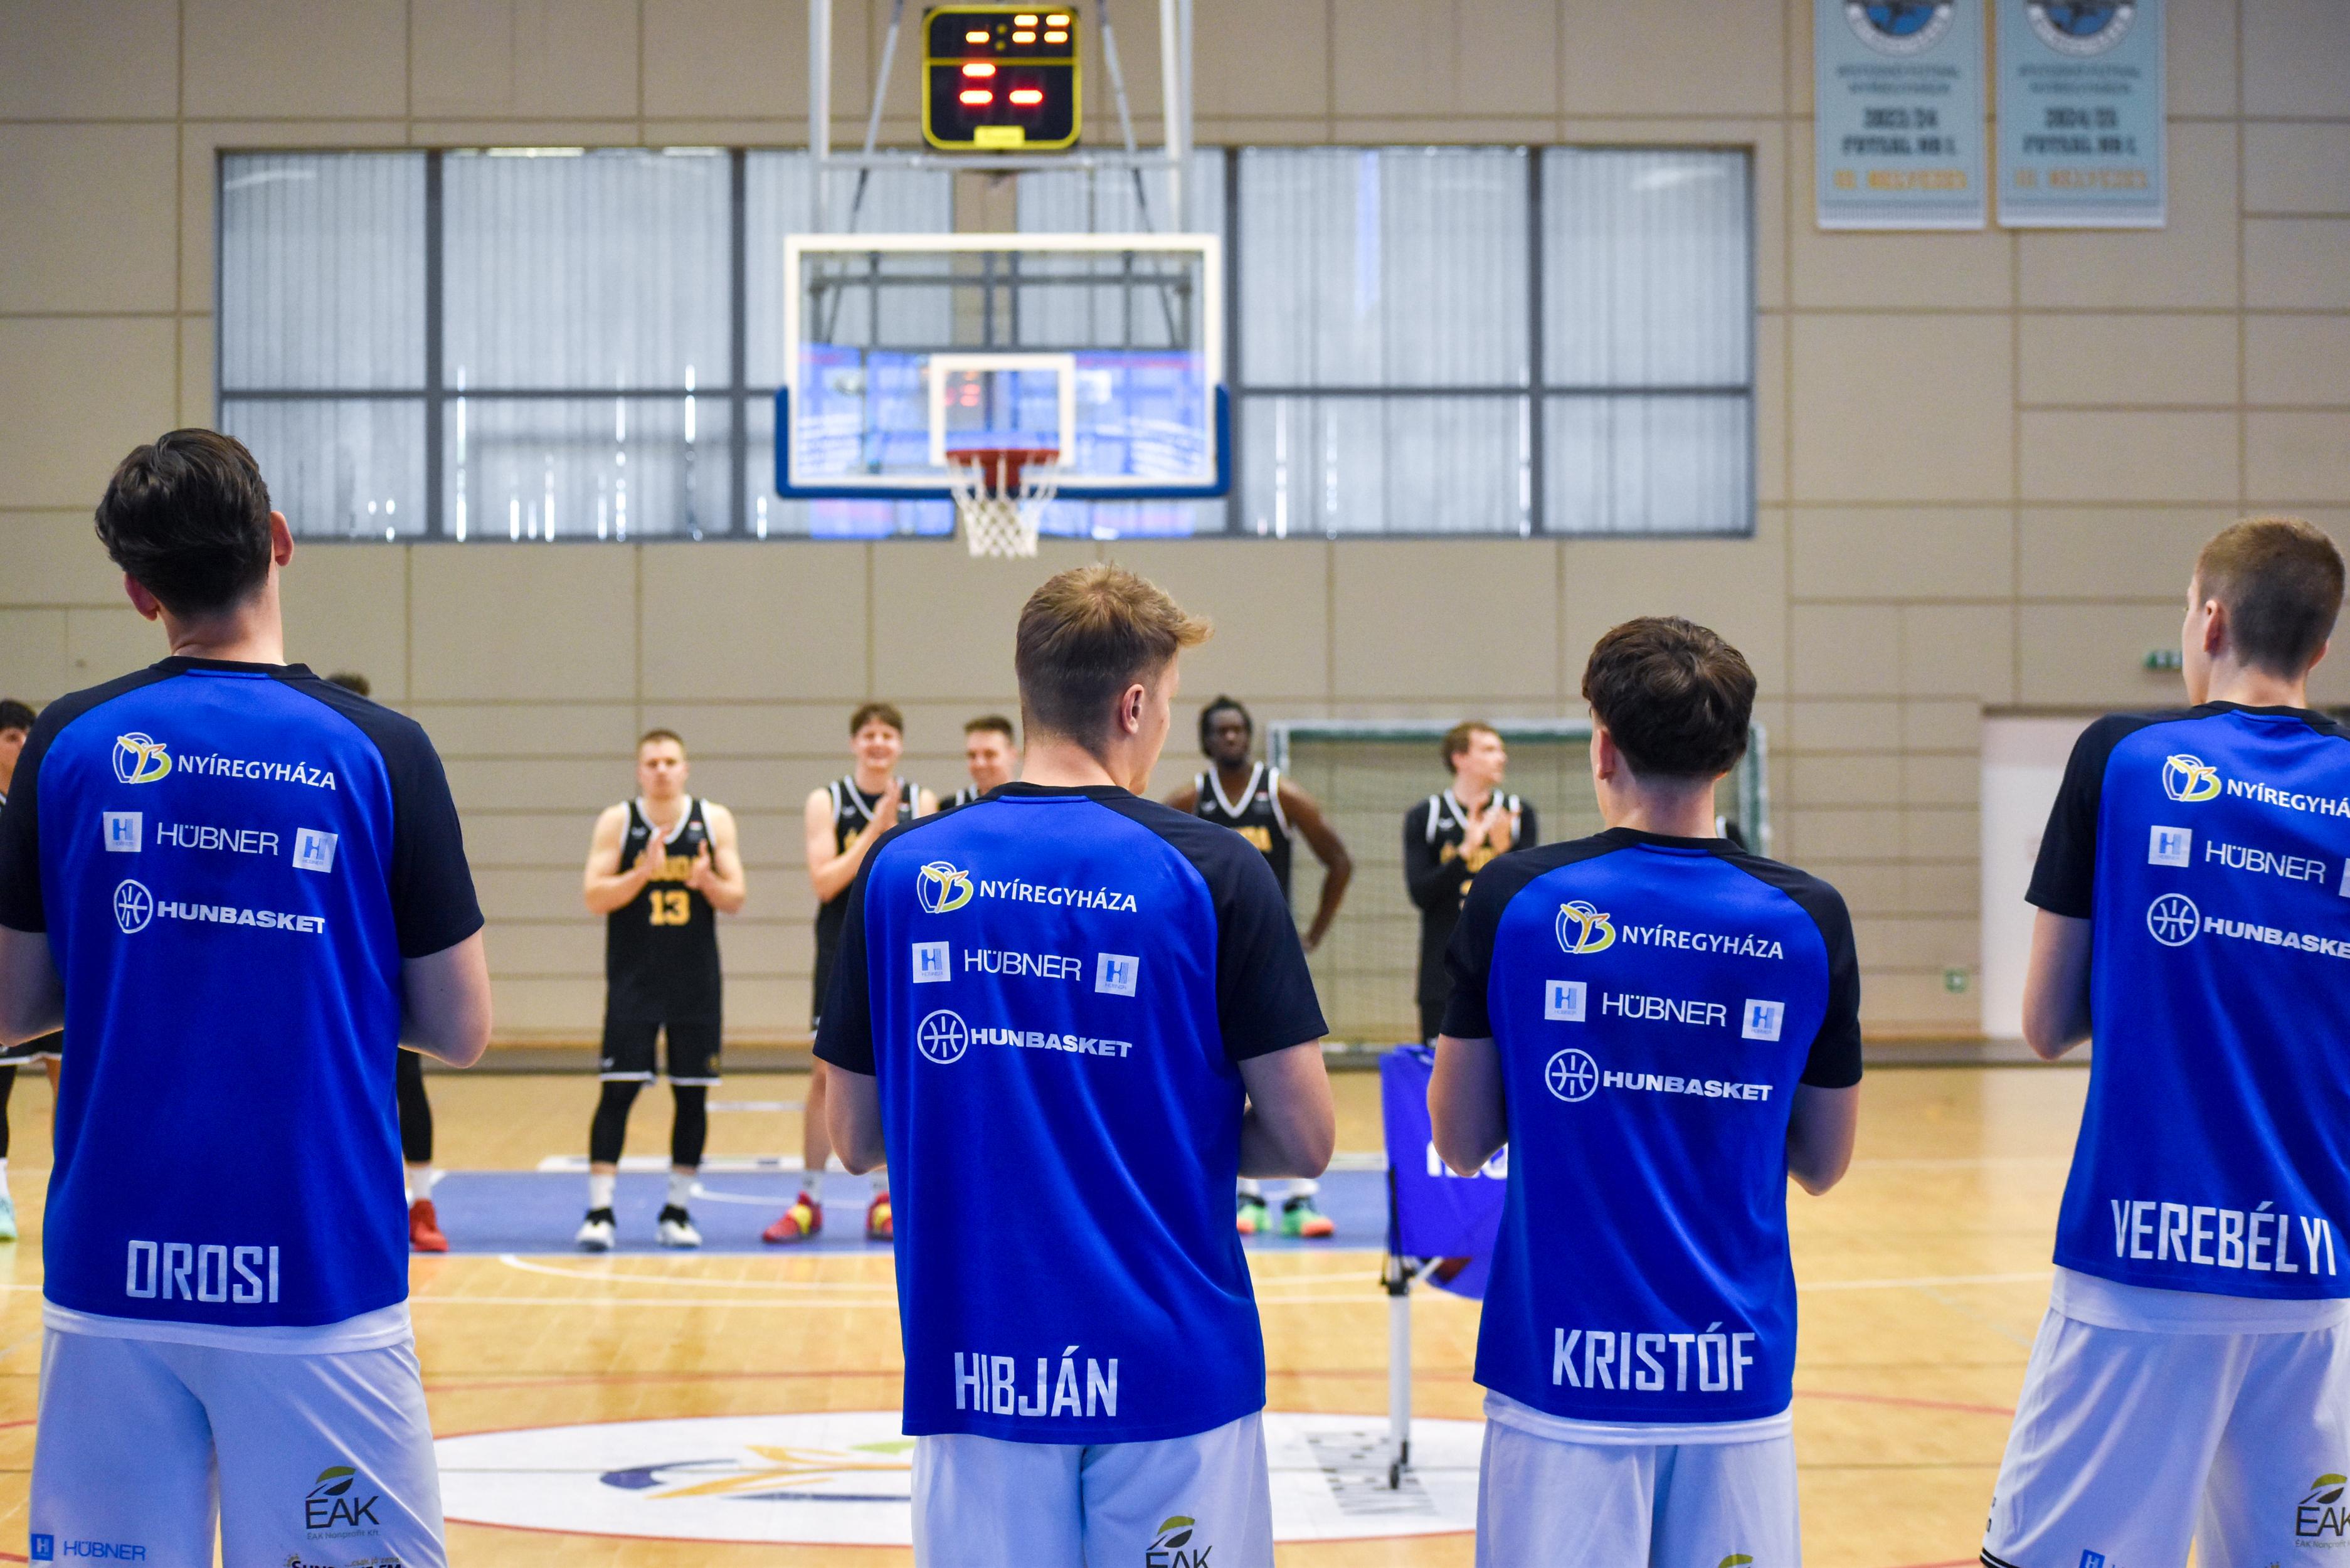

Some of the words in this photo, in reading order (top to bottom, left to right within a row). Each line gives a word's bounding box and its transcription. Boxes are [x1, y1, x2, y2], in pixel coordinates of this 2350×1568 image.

[177, 753, 336, 790] NYÍREGYHÁZA
[157, 822, 279, 856] HÜBNER
[2205, 840, 2327, 884] HÜBNER
[650, 889, 691, 926] 13
[980, 878, 1137, 913] NYÍREGYHÁZA
[157, 901, 326, 934] HUNBASKET
[1622, 924, 1784, 960] NYÍREGYHÁZA
[964, 949, 1082, 982] HÜBNER
[1602, 992, 1727, 1027] HÜBNER
[970, 1028, 1133, 1057] HUNBASKET
[1602, 1070, 1773, 1101] HUNBASKET
[2111, 1200, 2337, 1276] VEREBÉLYI
[126, 1239, 279, 1304] OROSI
[1553, 1322, 1755, 1392] KRISTÓF
[954, 1345, 1118, 1417] HIBJÁN
[64, 1540, 147, 1562] HÜBNER
